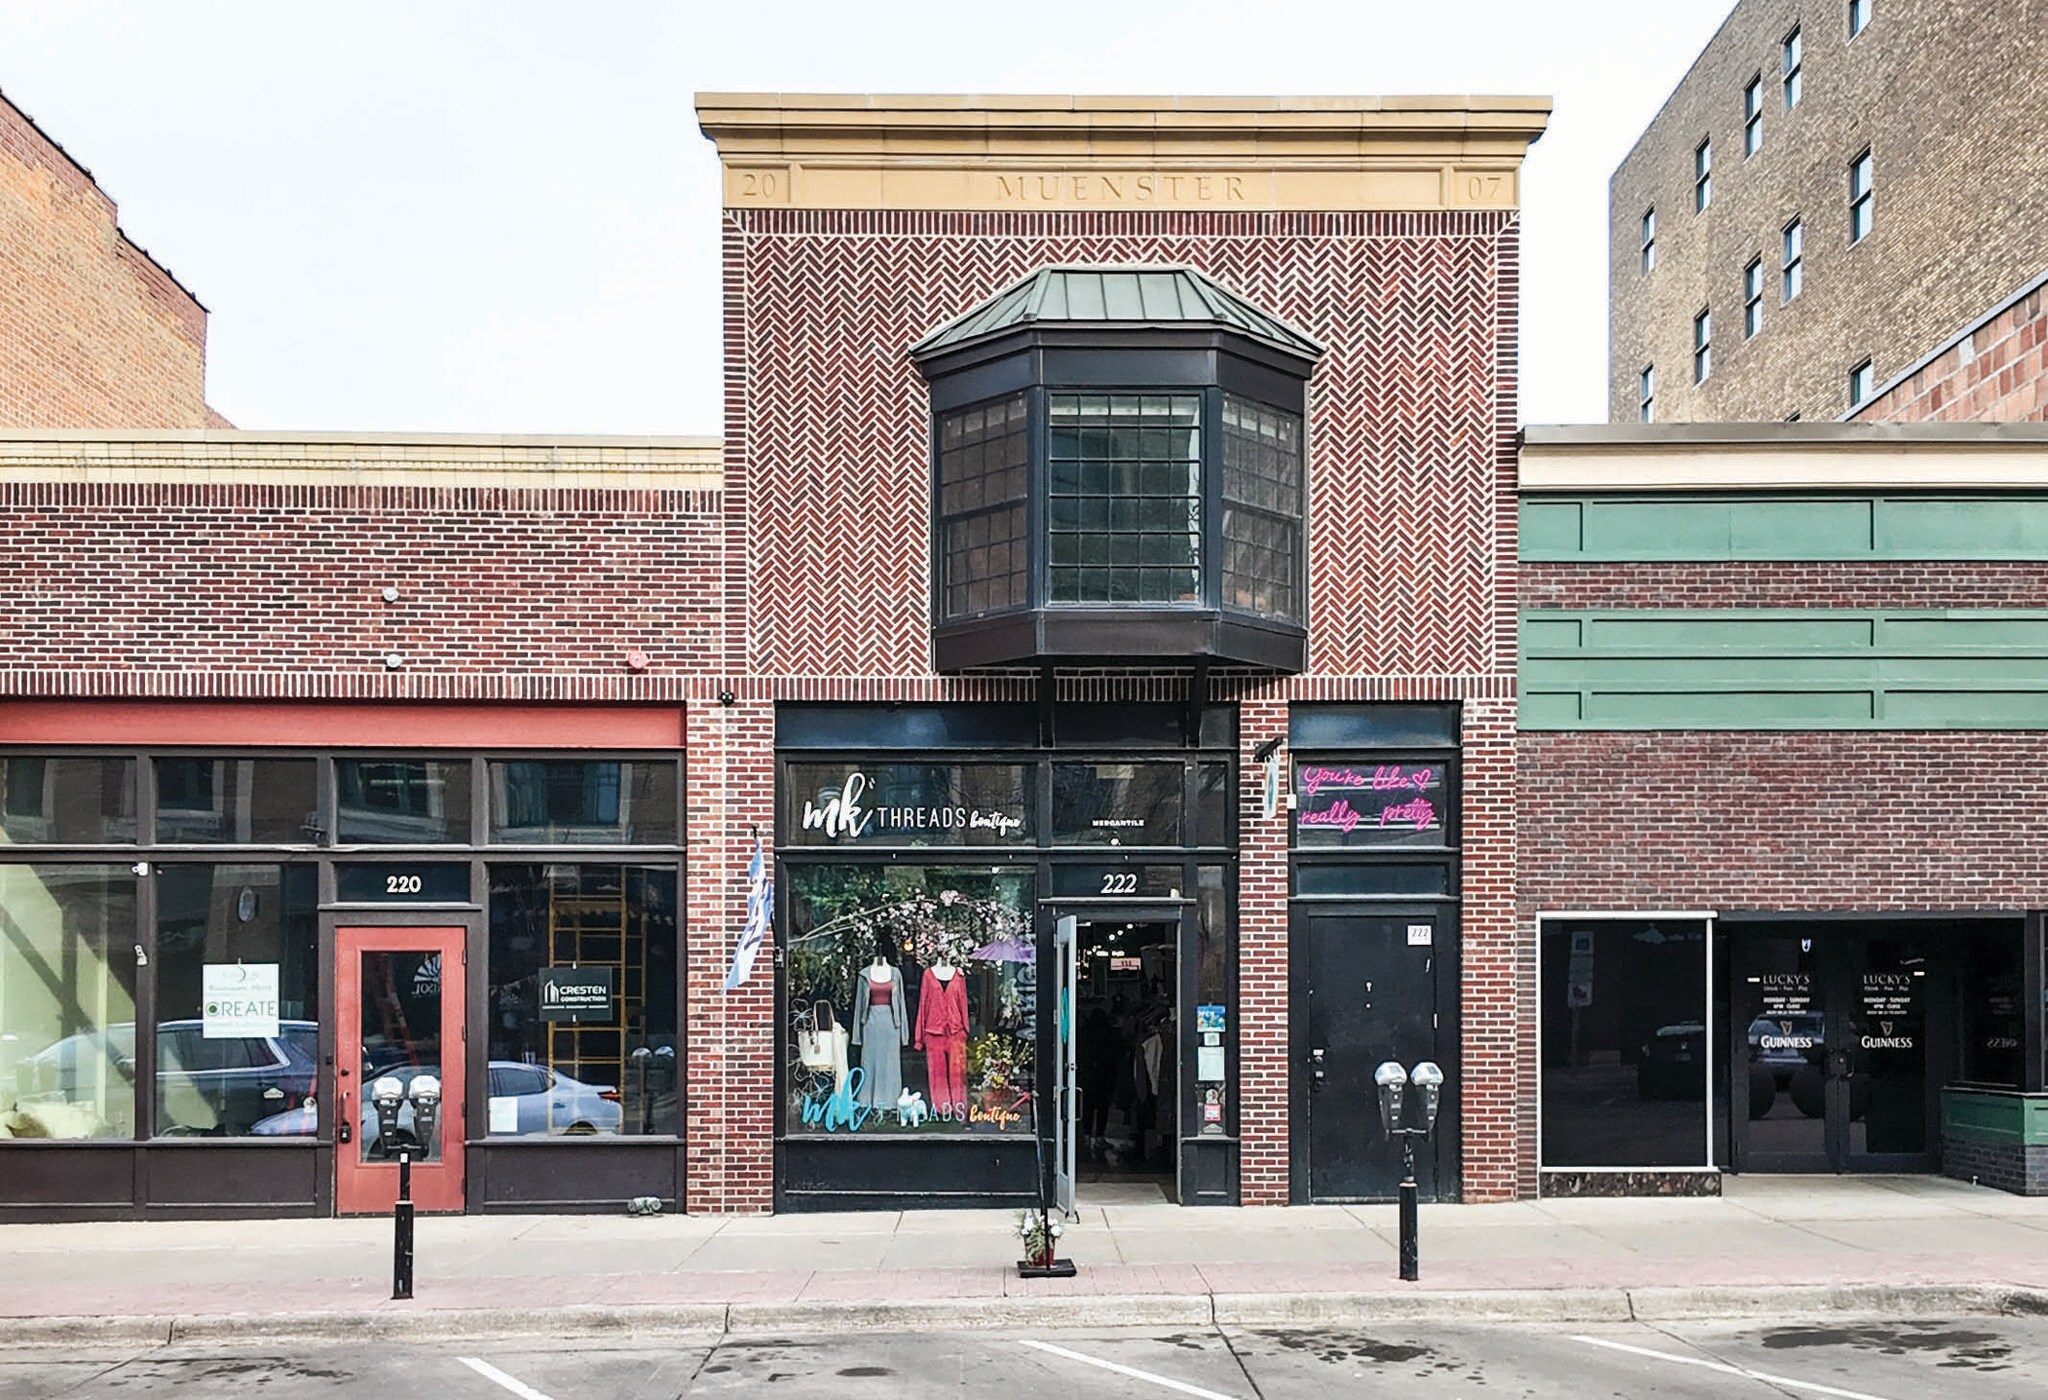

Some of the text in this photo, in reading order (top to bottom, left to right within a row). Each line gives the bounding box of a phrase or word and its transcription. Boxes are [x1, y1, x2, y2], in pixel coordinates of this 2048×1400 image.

[742, 173, 776, 199] 20
[996, 175, 1245, 201] MUENSTER
[1468, 176, 1502, 201] 07
[1373, 765, 1410, 790] like
[876, 806, 967, 829] THREADS
[969, 810, 1021, 837] boutique
[1092, 819, 1145, 827] MERCANTILE
[1301, 797, 1435, 832] really pretty
[386, 875, 422, 893] 220
[1101, 873, 1137, 894] 222
[1763, 974, 1810, 985] LUCKY'S
[1864, 974, 1911, 985] LUCKY'S
[560, 985, 607, 995] CRESTEN
[206, 1001, 277, 1017] CREATE
[1760, 1035, 1813, 1048] GUINNESS
[1861, 1035, 1913, 1048] GUINNESS
[802, 1067, 872, 1132] mk
[969, 1104, 1021, 1131] boutique
